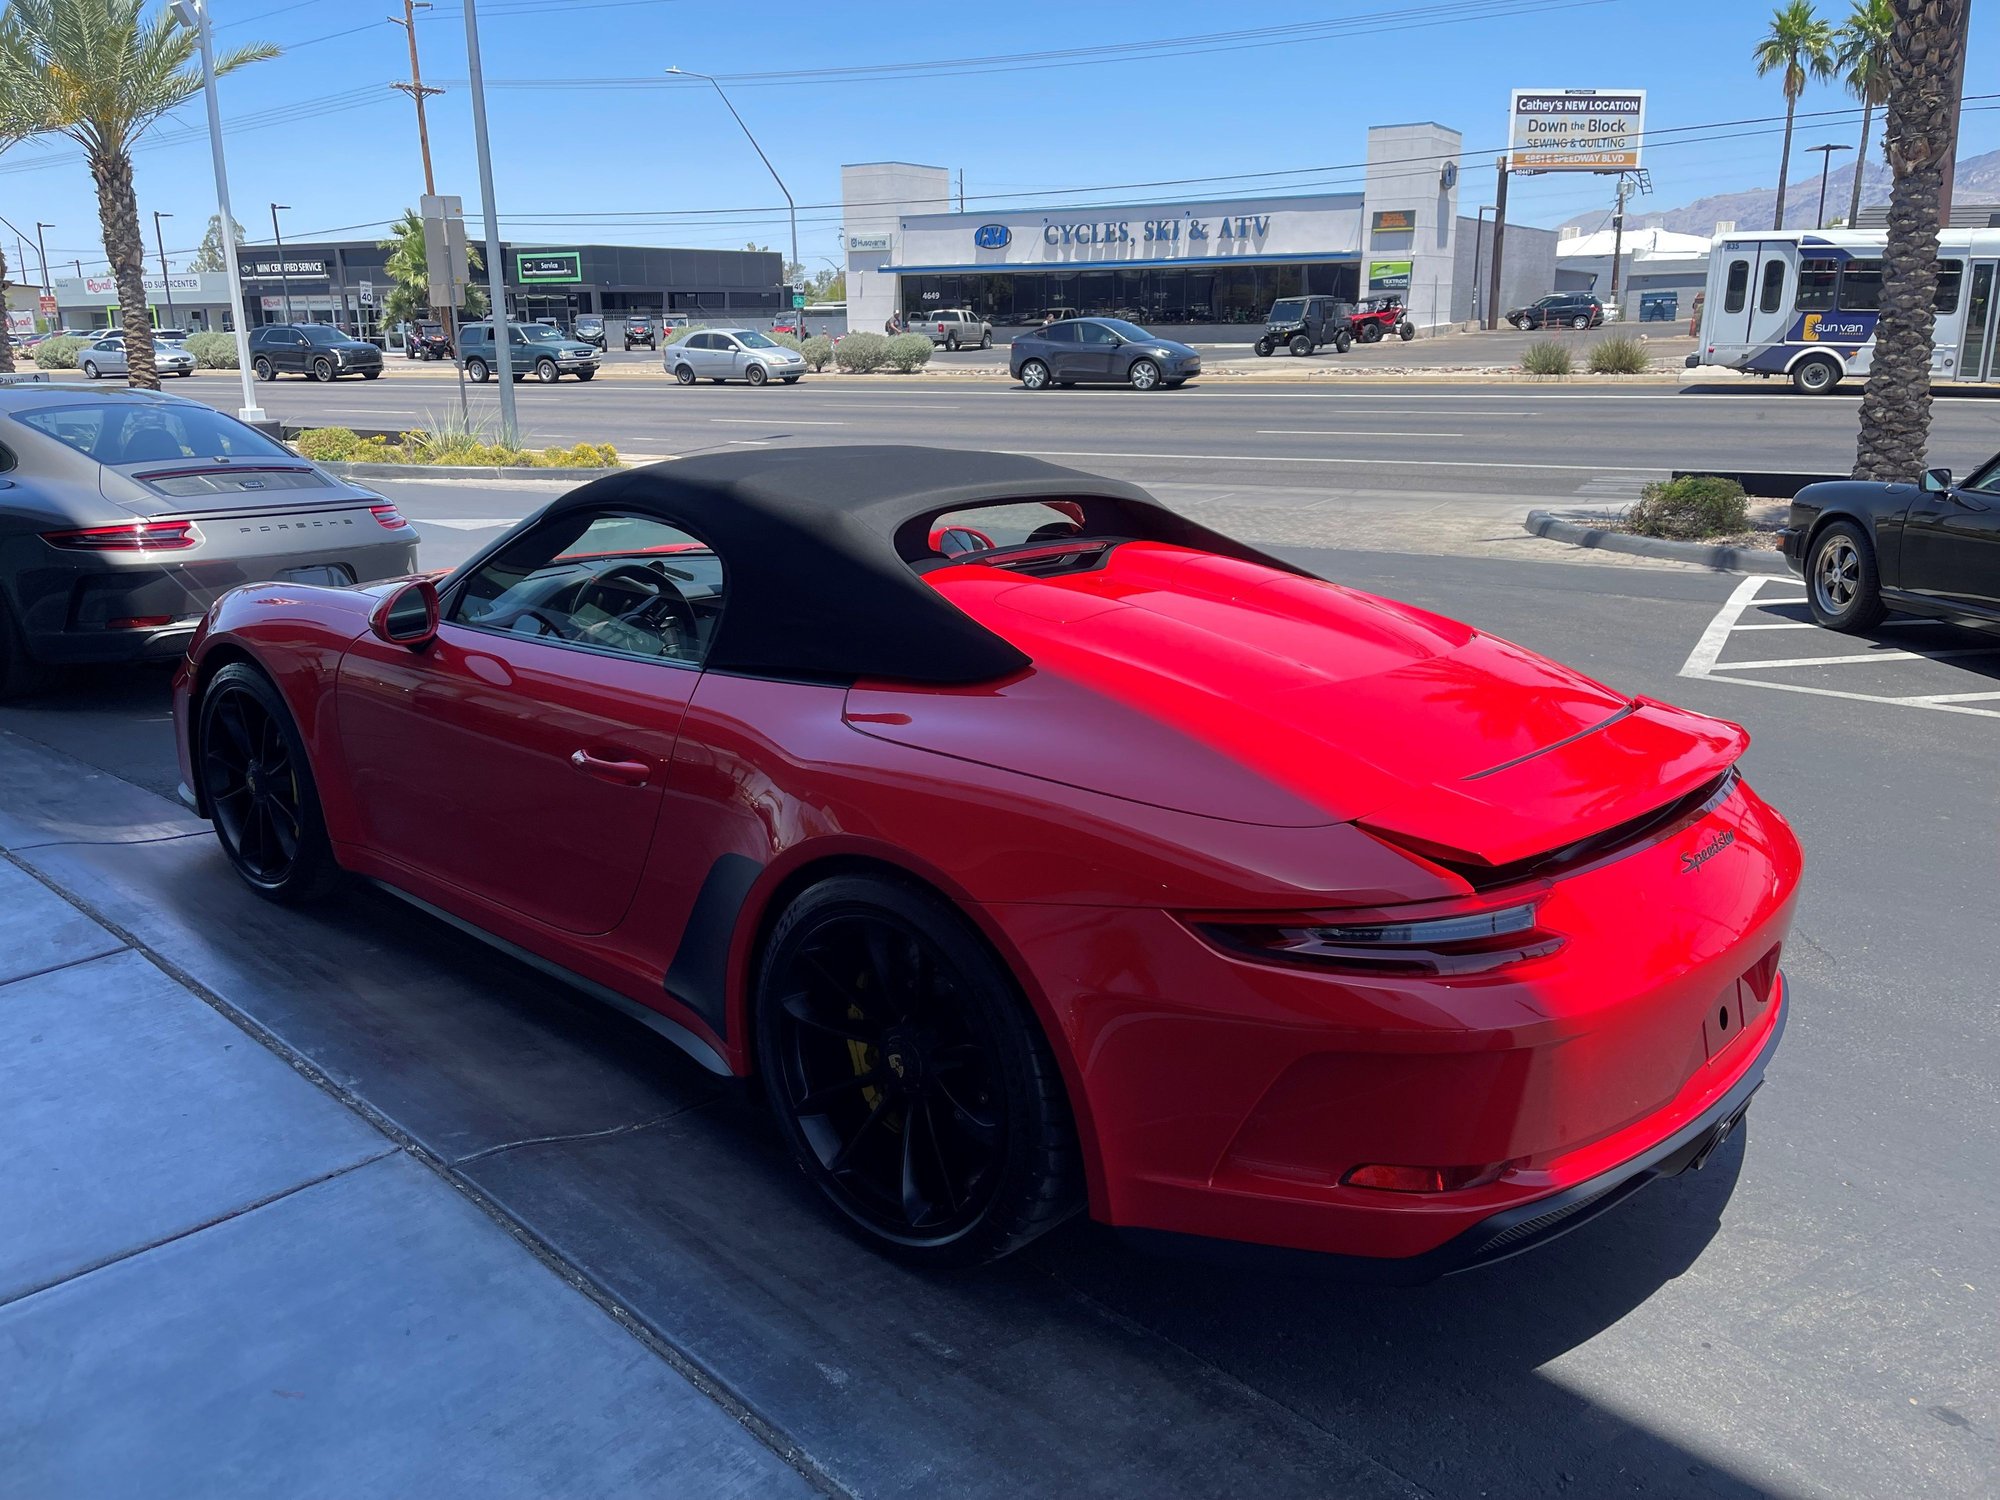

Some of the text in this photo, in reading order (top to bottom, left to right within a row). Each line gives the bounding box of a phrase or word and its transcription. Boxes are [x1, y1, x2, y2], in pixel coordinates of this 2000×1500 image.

[1519, 98, 1639, 113] Cathey's NEW LOCATION
[1528, 119, 1626, 132] Down the Block
[1527, 138, 1625, 149] SEWING & QUILTING
[1553, 154, 1599, 163] SPEEDWAY
[1602, 154, 1625, 163] BLVD
[1044, 215, 1271, 247] CYCLES, SKI & ATV
[857, 238, 887, 248] Husqvarna
[257, 262, 322, 273] MINI CERIFIED SERVICE
[86, 278, 113, 294] Royal
[154, 279, 197, 288] SUPRCENTER
[794, 282, 804, 290] 40
[361, 293, 372, 302] 40
[922, 291, 940, 300] 4649
[1814, 323, 1864, 333] sun van
[240, 519, 353, 533] PORSCHE
[1680, 828, 1735, 874] Speedster
